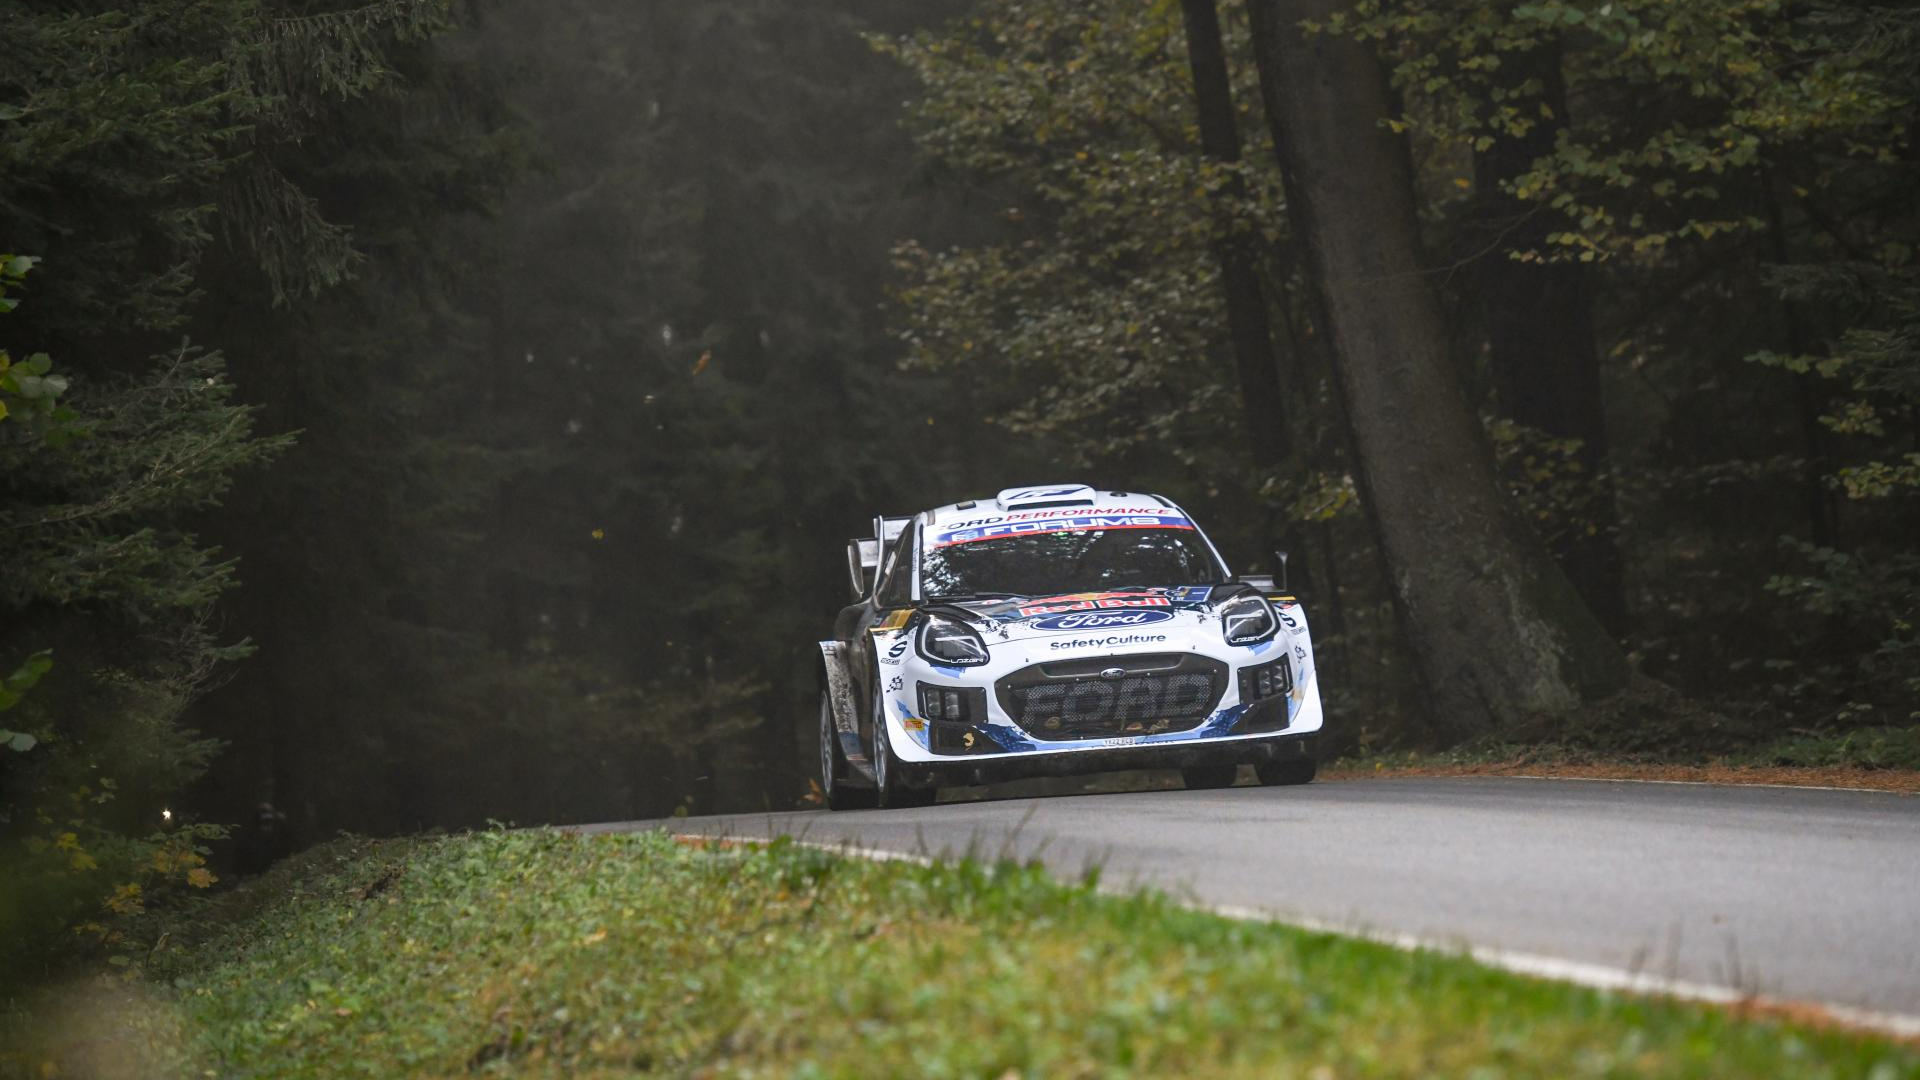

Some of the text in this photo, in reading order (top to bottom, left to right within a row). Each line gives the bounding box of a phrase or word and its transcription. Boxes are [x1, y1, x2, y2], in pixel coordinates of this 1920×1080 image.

[940, 507, 1170, 531] ORD PERFORMANCE
[983, 517, 1161, 536] FORUM8
[1018, 597, 1172, 617] Red Bull
[1057, 610, 1148, 629] Ford
[1050, 634, 1167, 650] SafetyCulture
[1022, 673, 1212, 726] FORD
